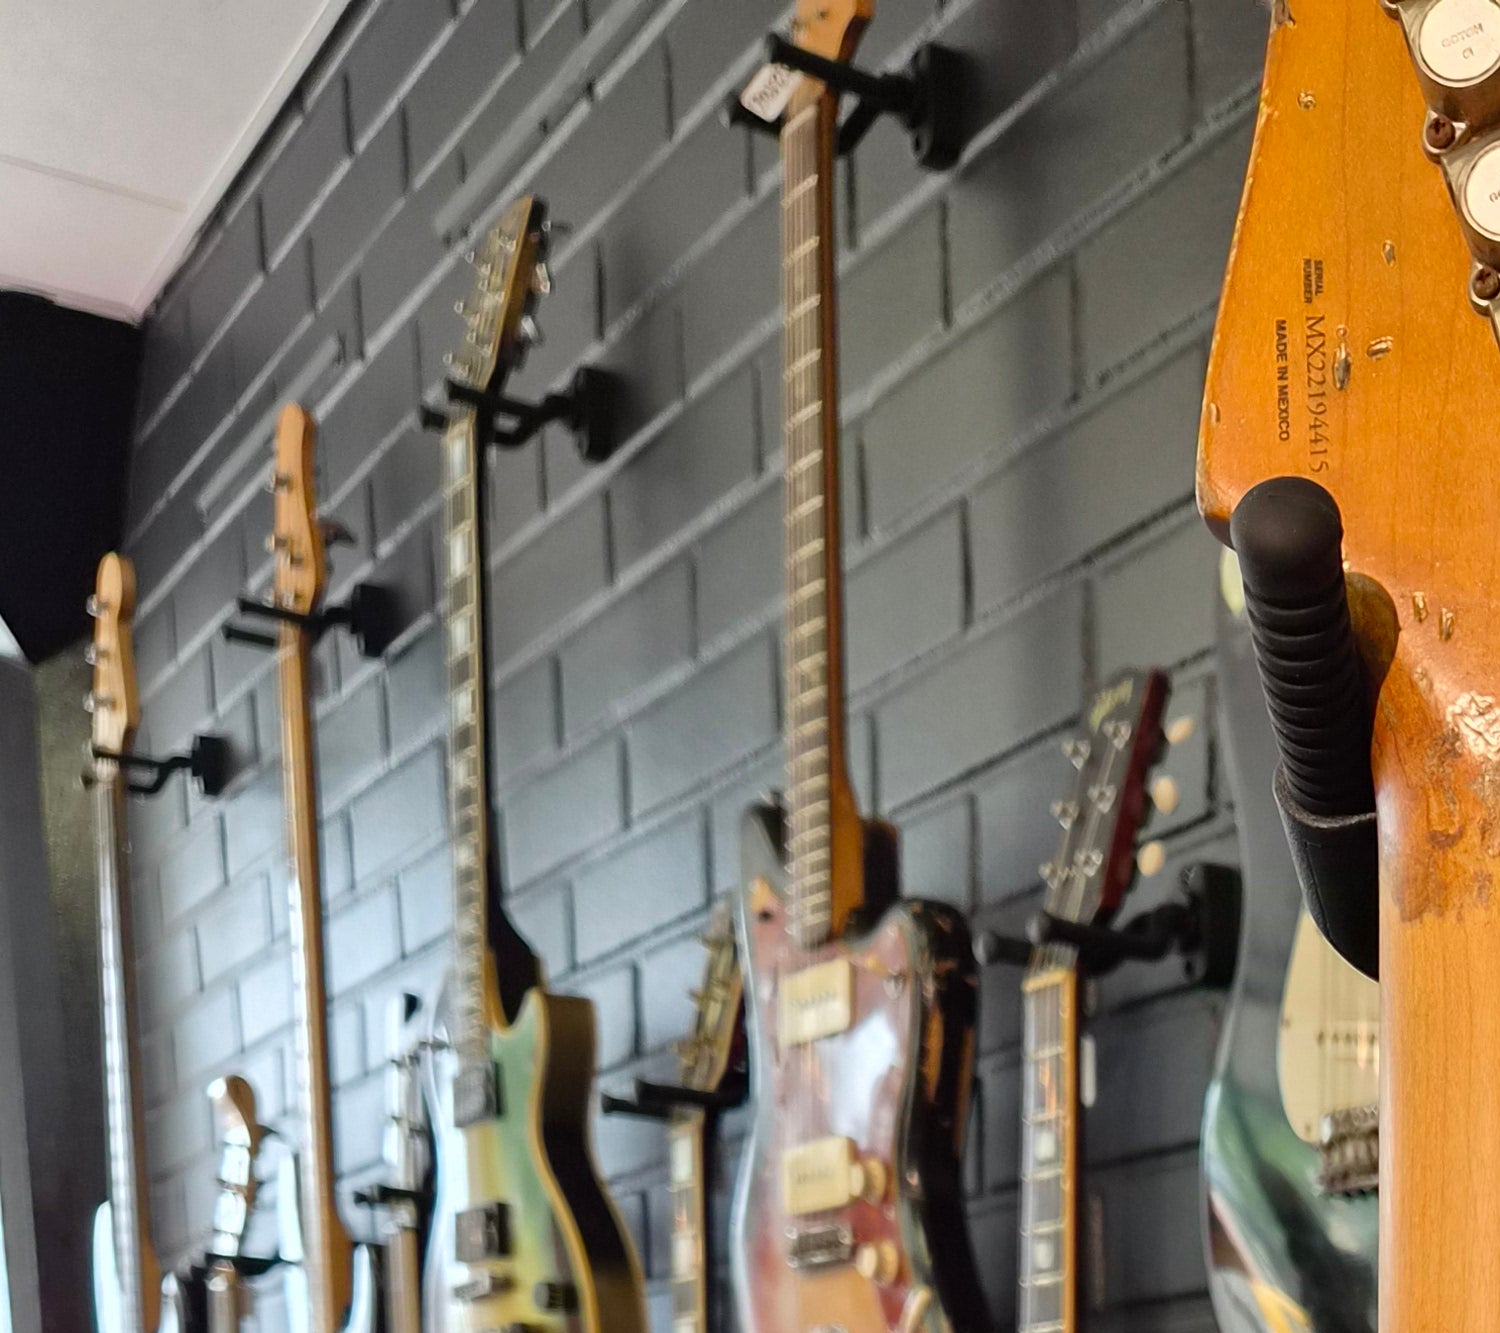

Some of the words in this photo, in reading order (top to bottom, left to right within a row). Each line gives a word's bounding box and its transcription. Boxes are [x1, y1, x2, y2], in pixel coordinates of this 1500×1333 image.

[1303, 257, 1314, 304] NUMBER
[1314, 260, 1324, 296] SERIAL
[1276, 319, 1288, 362] MADE
[1277, 366, 1288, 381] IN
[1305, 314, 1330, 474] MX22194415
[1278, 384, 1290, 442] MEXICO
